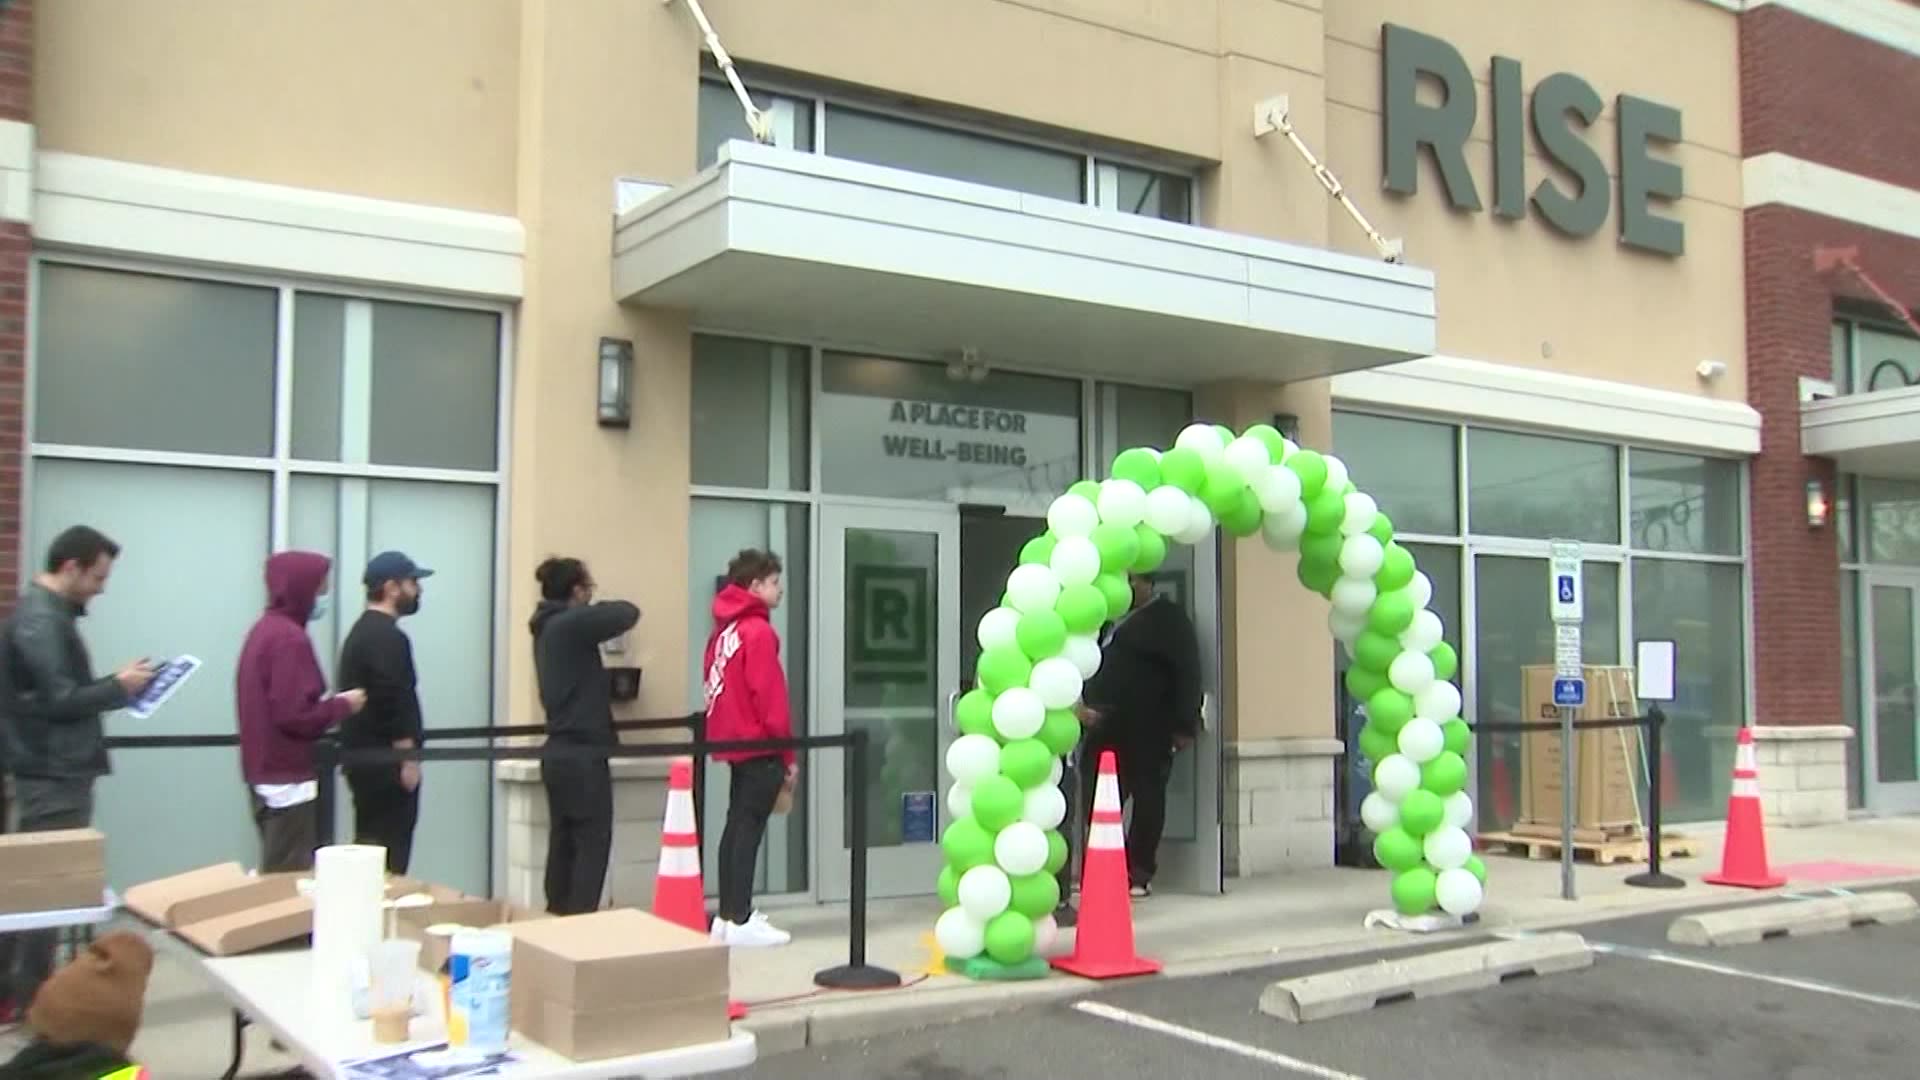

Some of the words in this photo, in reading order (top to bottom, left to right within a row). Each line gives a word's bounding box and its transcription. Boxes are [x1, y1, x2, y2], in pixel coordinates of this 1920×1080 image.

[1382, 22, 1685, 257] RISE
[889, 400, 907, 422] A
[910, 402, 979, 429] PLACE
[983, 409, 1026, 433] FOR
[882, 434, 1027, 467] WELL-BEING
[872, 588, 910, 640] R
